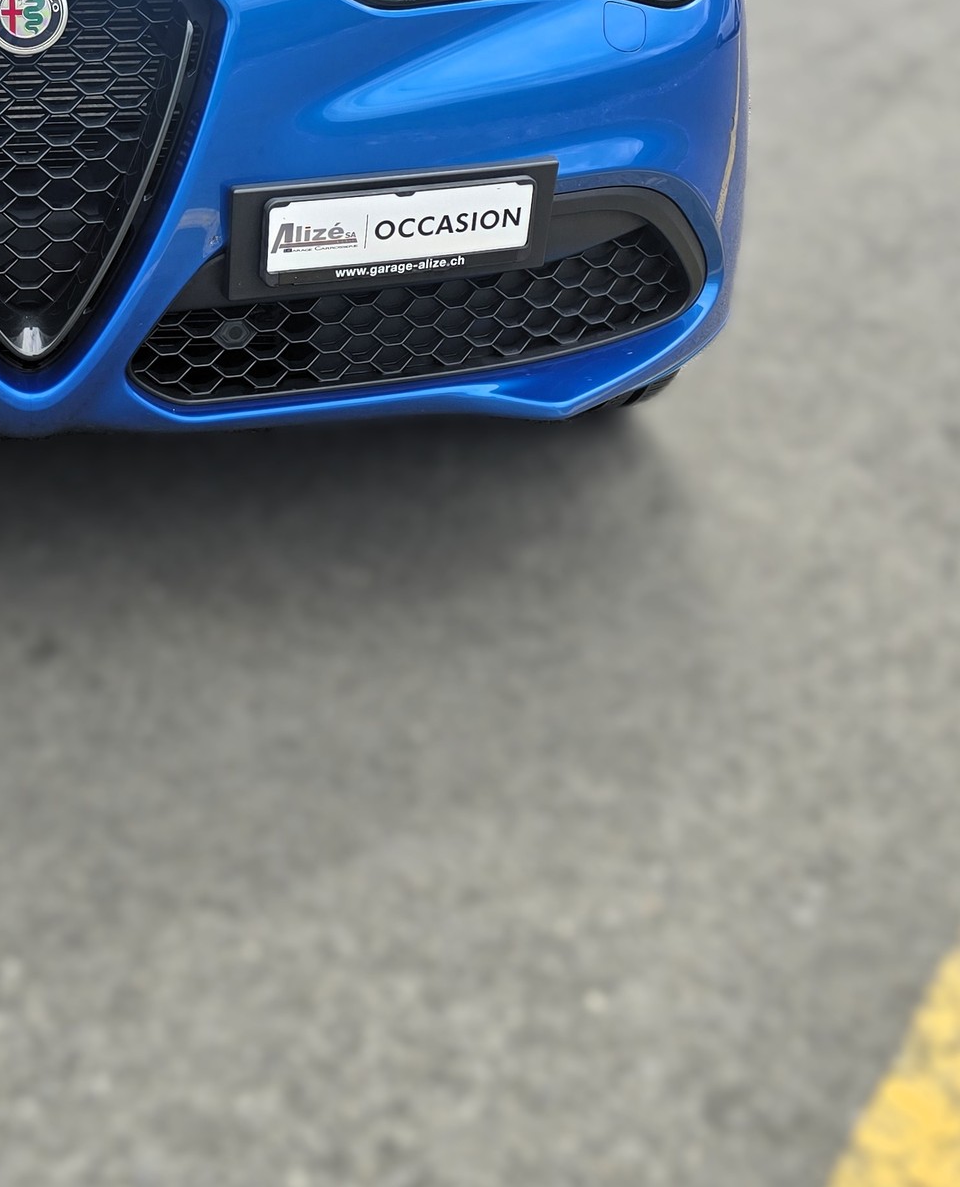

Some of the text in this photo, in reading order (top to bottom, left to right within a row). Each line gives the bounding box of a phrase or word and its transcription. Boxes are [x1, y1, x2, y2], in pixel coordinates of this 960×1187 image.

[270, 222, 357, 254] Alizé SA
[374, 207, 522, 241] OCCASION
[335, 255, 465, 278] www.garage-alize.ch
